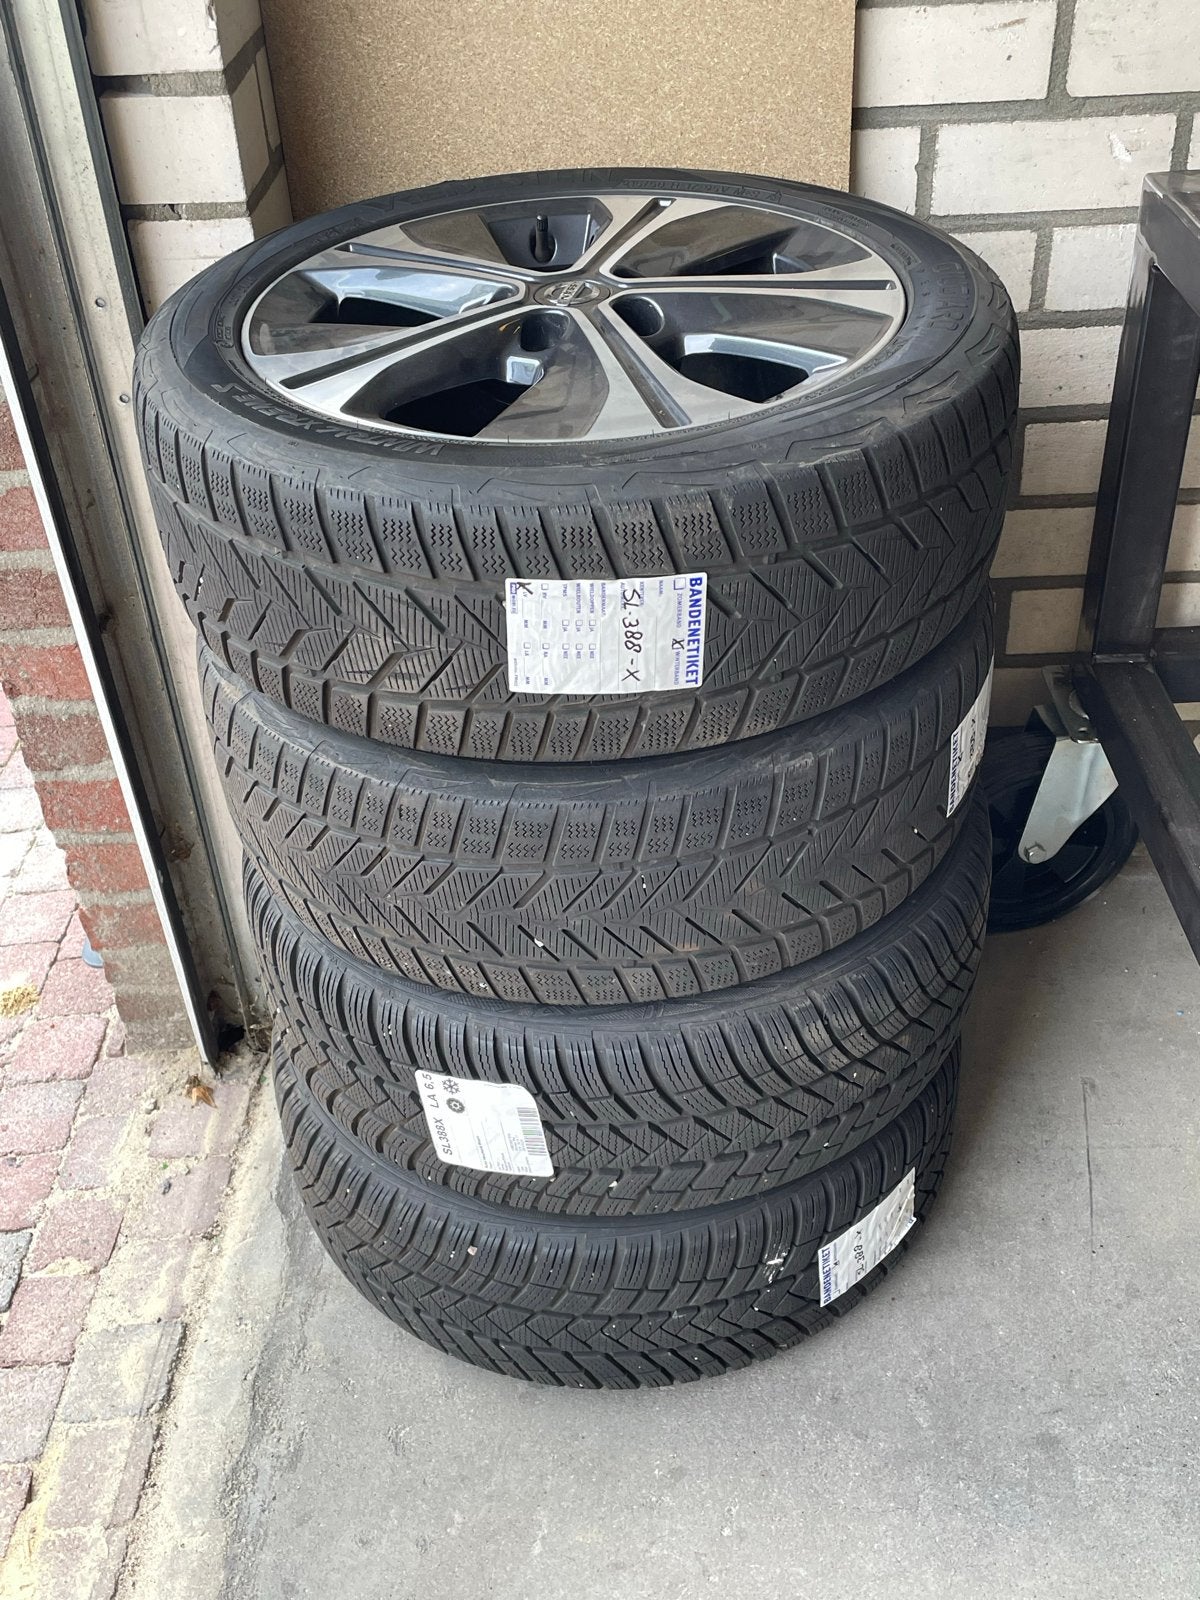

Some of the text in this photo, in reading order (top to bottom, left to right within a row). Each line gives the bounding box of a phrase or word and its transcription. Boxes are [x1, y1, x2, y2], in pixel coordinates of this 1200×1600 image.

[686, 577, 703, 685] BANDENETIKET
[427, 1094, 439, 1109] LA
[433, 1117, 453, 1156] SL388X
[821, 1247, 832, 1304] BANDENETIKET
